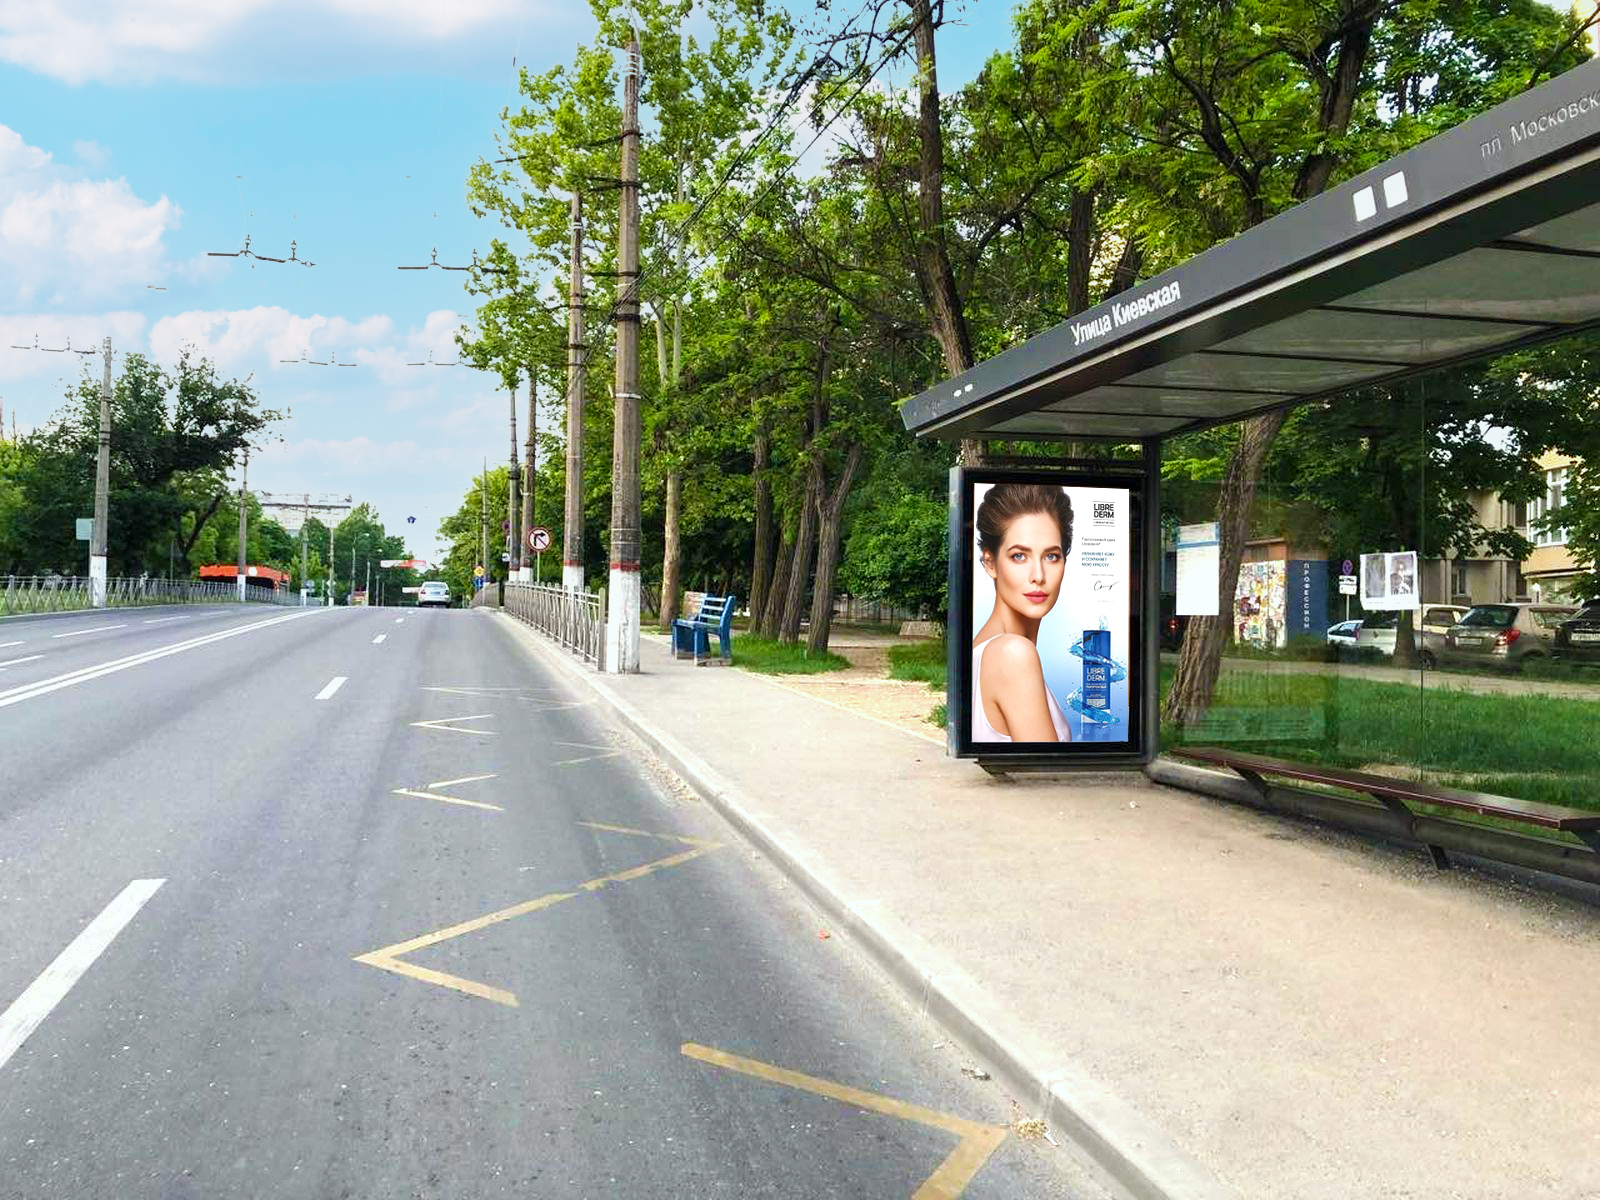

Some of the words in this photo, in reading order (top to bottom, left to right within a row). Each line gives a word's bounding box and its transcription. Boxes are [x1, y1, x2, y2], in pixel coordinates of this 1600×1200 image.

[1070, 314, 1113, 346] Улица
[1112, 281, 1181, 327] Киевская
[1093, 503, 1114, 511] LIBRE
